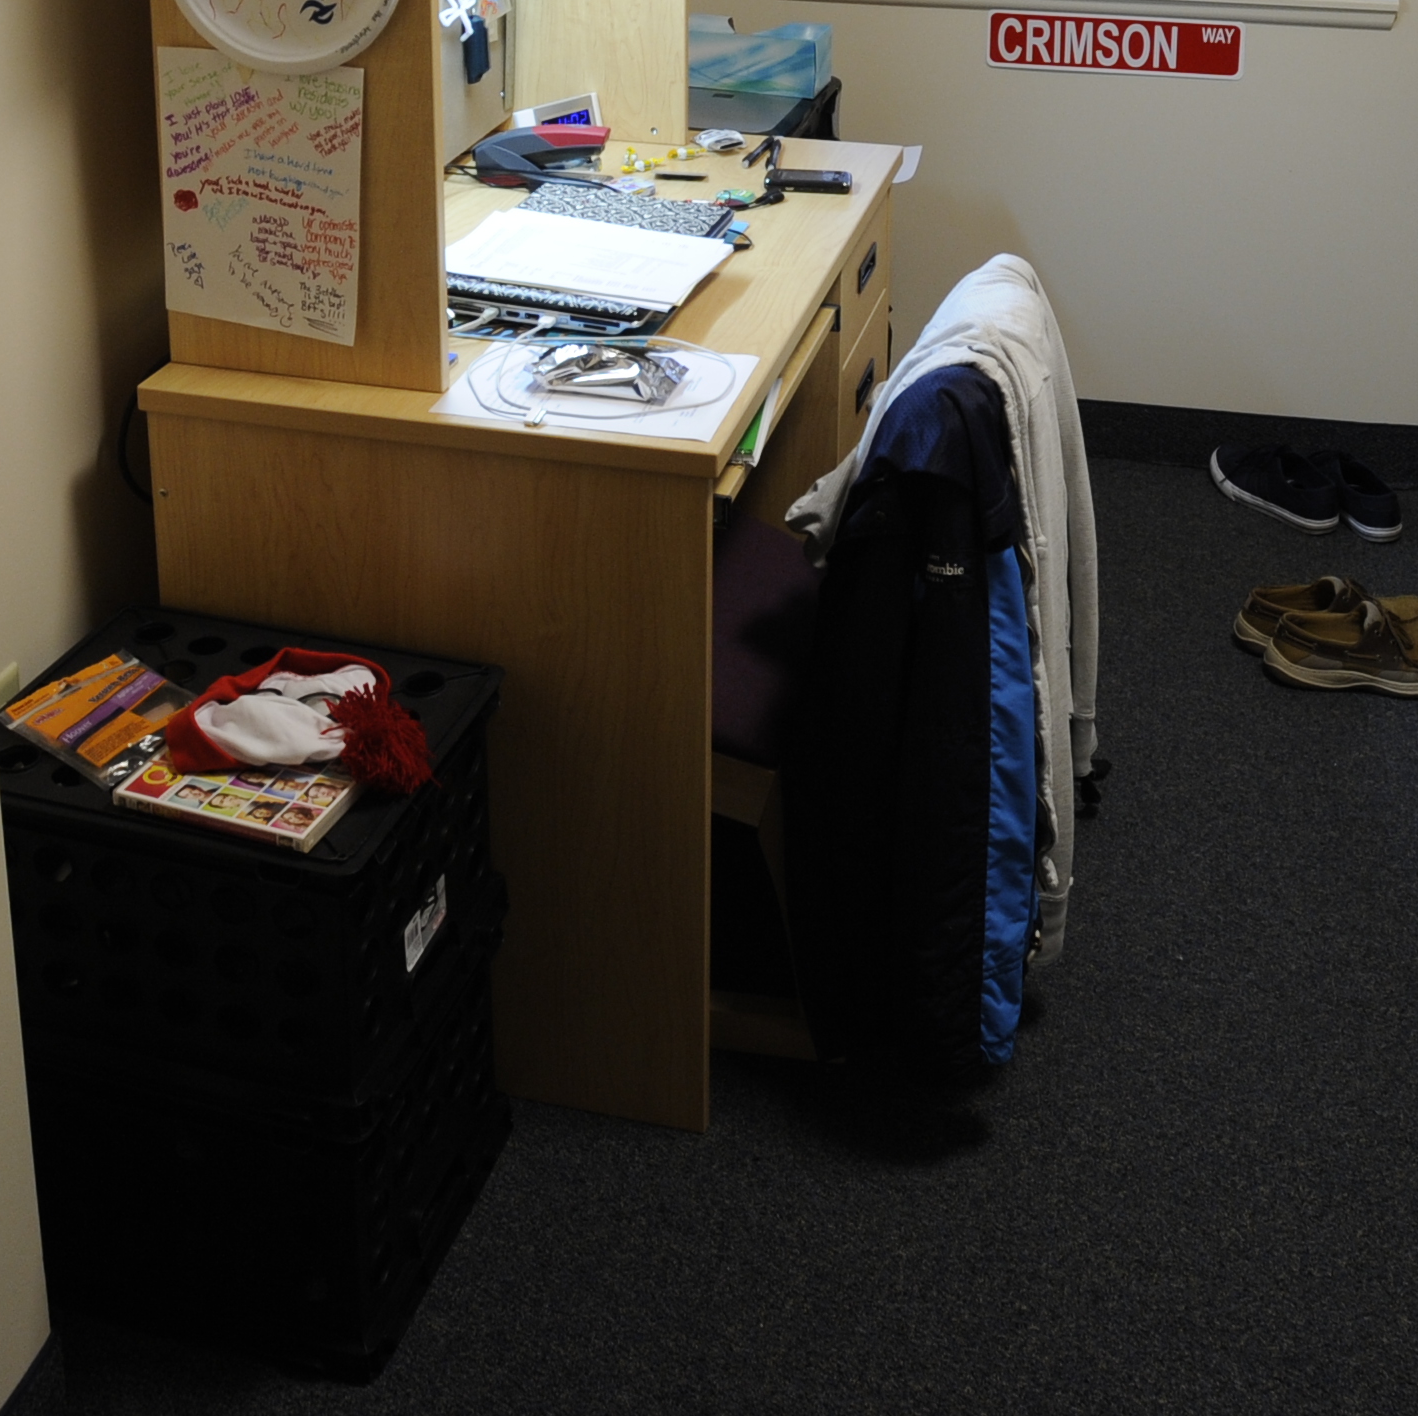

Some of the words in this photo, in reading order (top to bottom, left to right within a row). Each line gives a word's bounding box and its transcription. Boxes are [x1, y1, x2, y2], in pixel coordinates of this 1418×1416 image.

[998, 17, 1178, 70] CRIMSON
[1201, 27, 1236, 44] WAY
[164, 114, 178, 127] I
[61, 720, 92, 744] Hoover
